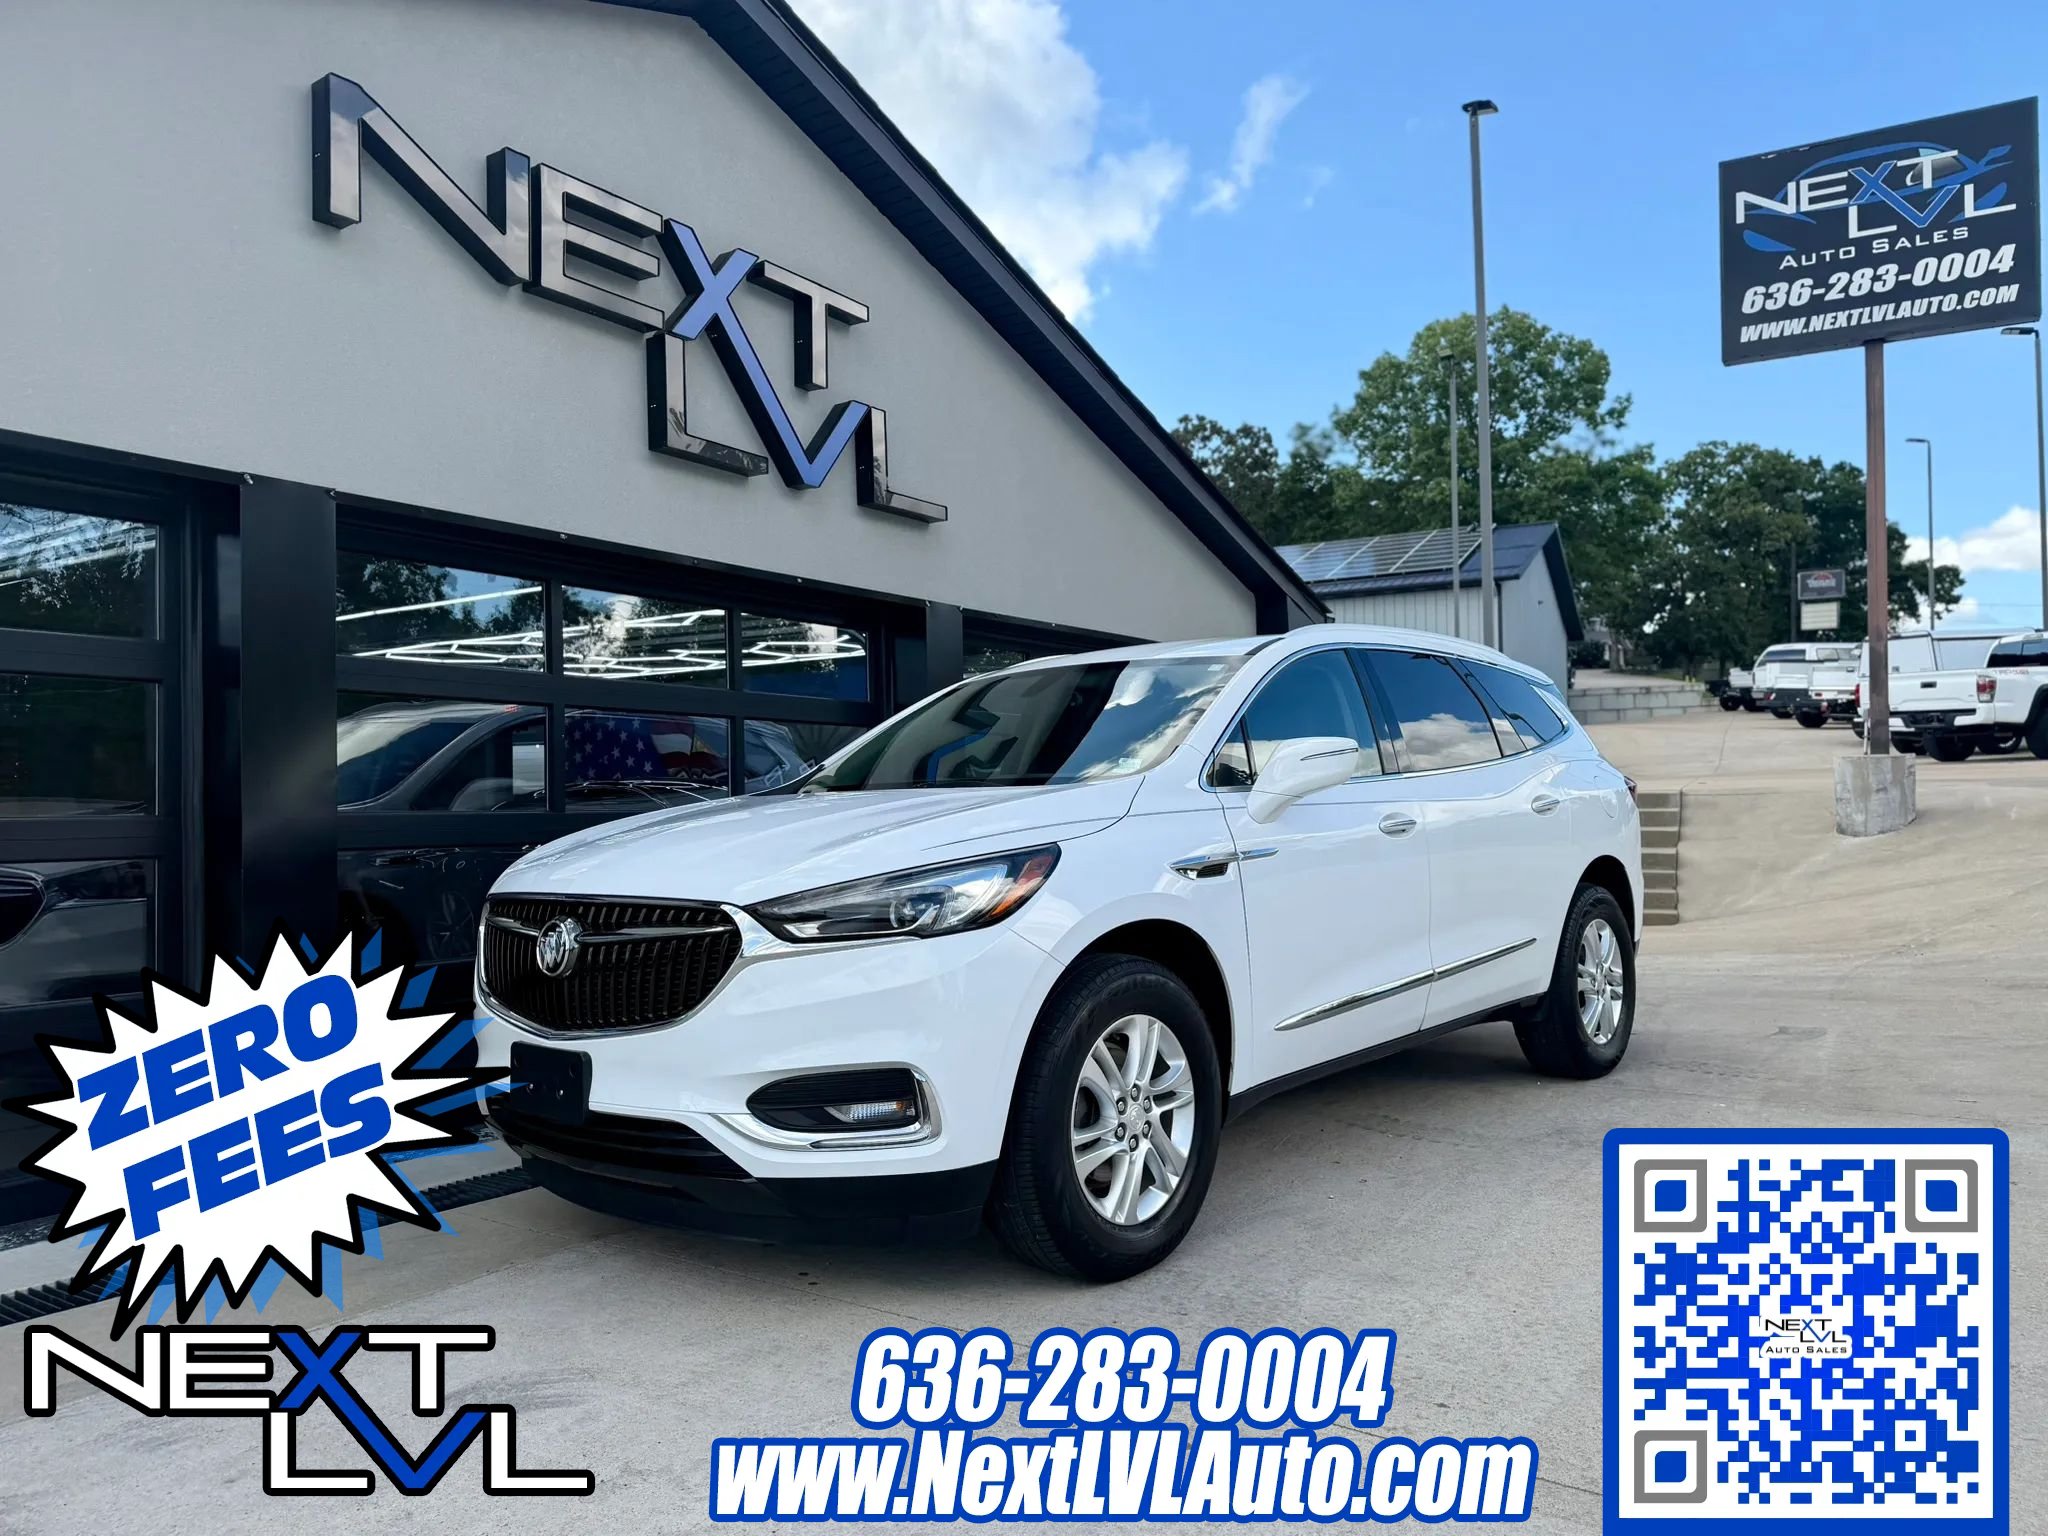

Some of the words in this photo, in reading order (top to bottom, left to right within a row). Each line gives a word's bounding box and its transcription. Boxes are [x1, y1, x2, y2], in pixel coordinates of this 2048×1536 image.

[1735, 148, 1959, 224] NEXT
[1847, 183, 2017, 239] LVL
[311, 72, 870, 391] NEXT
[1778, 246, 1856, 271] AUTO
[1872, 226, 1969, 254] SALES
[1739, 283, 2020, 343] WWW.NEXTLVLAUTO.COM
[1740, 243, 2017, 315] 636-283-0004
[645, 330, 949, 524] LVL
